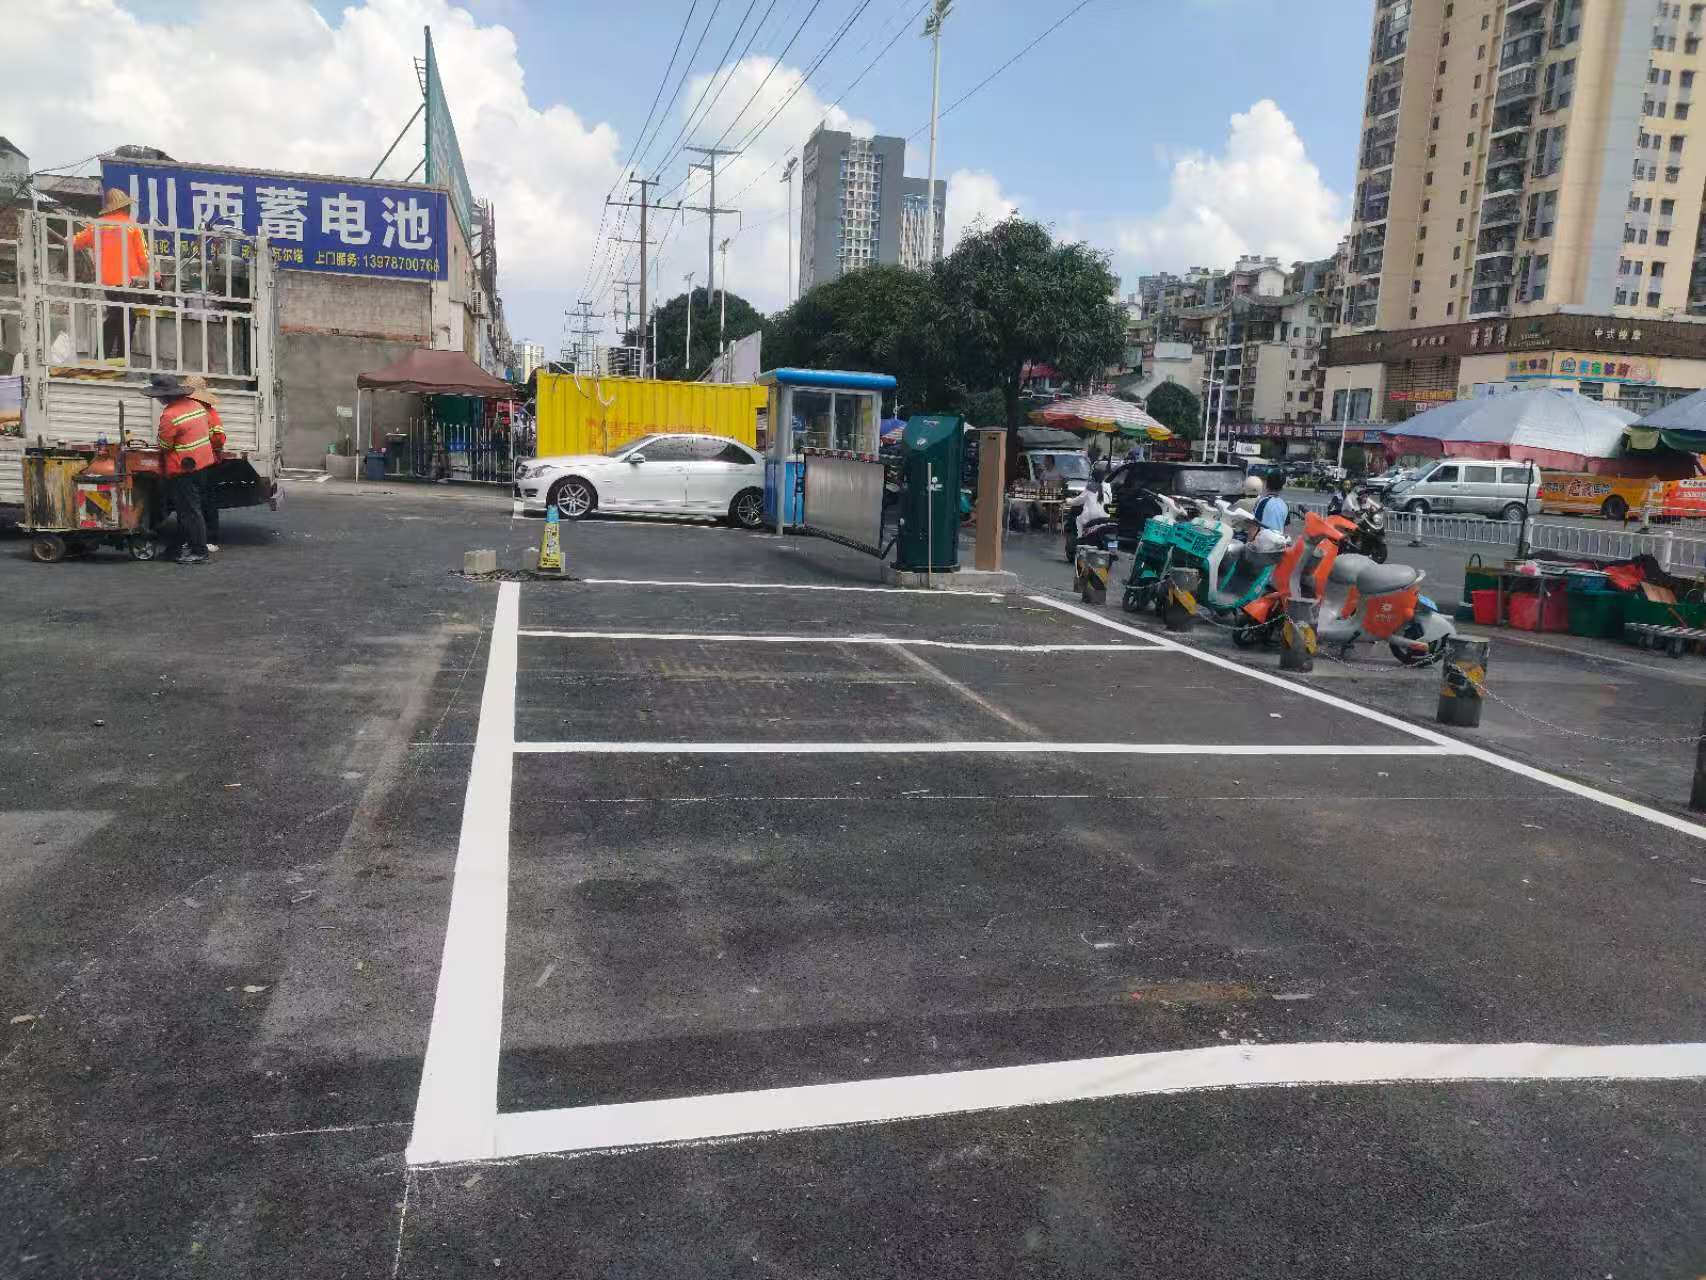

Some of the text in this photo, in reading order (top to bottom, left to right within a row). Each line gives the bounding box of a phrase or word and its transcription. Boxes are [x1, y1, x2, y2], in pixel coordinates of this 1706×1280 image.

[129, 174, 433, 250] 川西蓄电池
